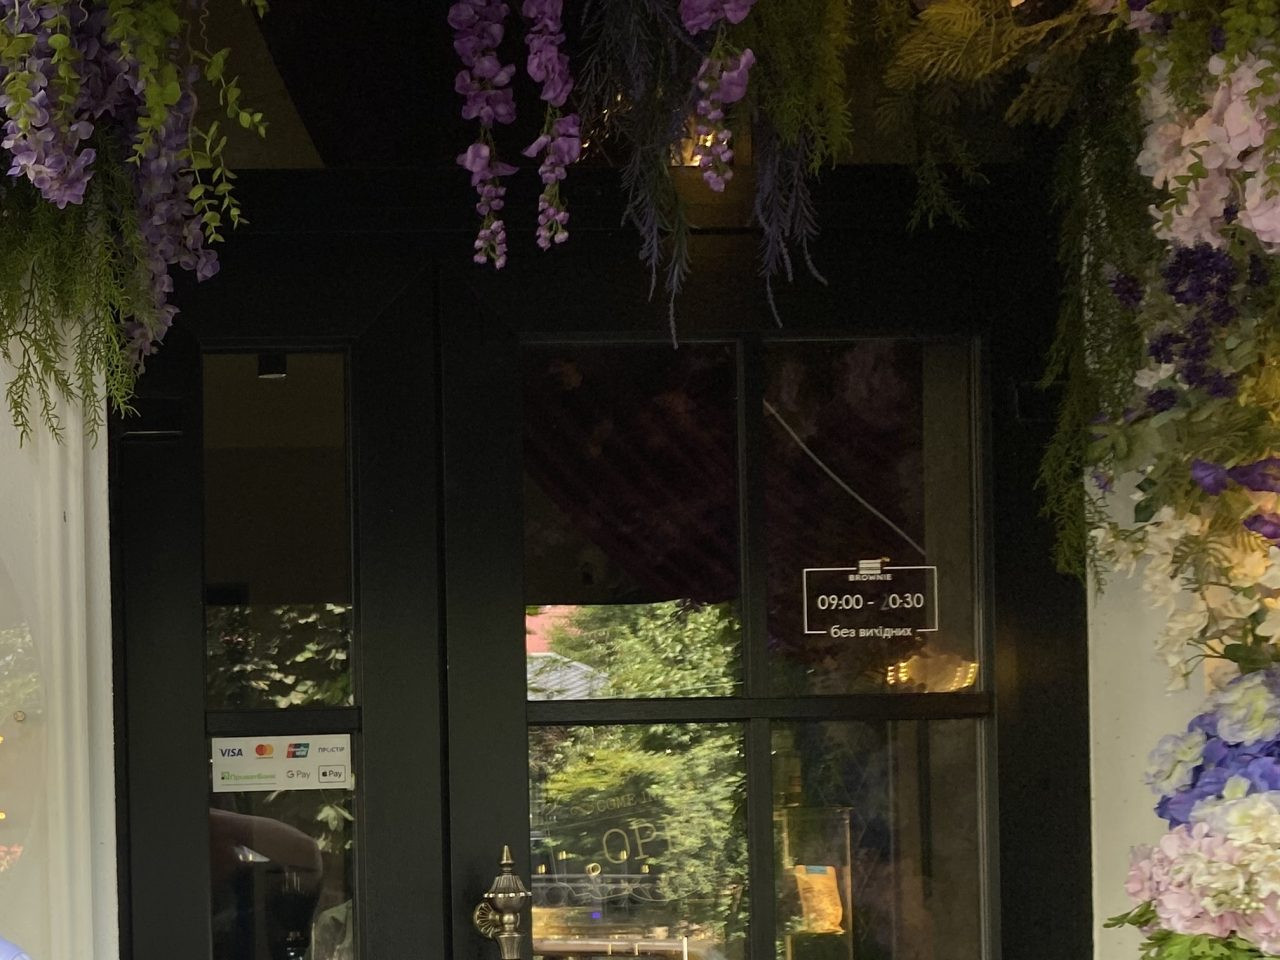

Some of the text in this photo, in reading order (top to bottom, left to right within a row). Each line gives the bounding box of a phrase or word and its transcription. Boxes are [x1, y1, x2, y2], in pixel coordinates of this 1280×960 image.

[817, 594, 863, 610] 09:00
[830, 625, 912, 639] без вихідних
[220, 748, 243, 757] VISA
[328, 770, 342, 778] Pay
